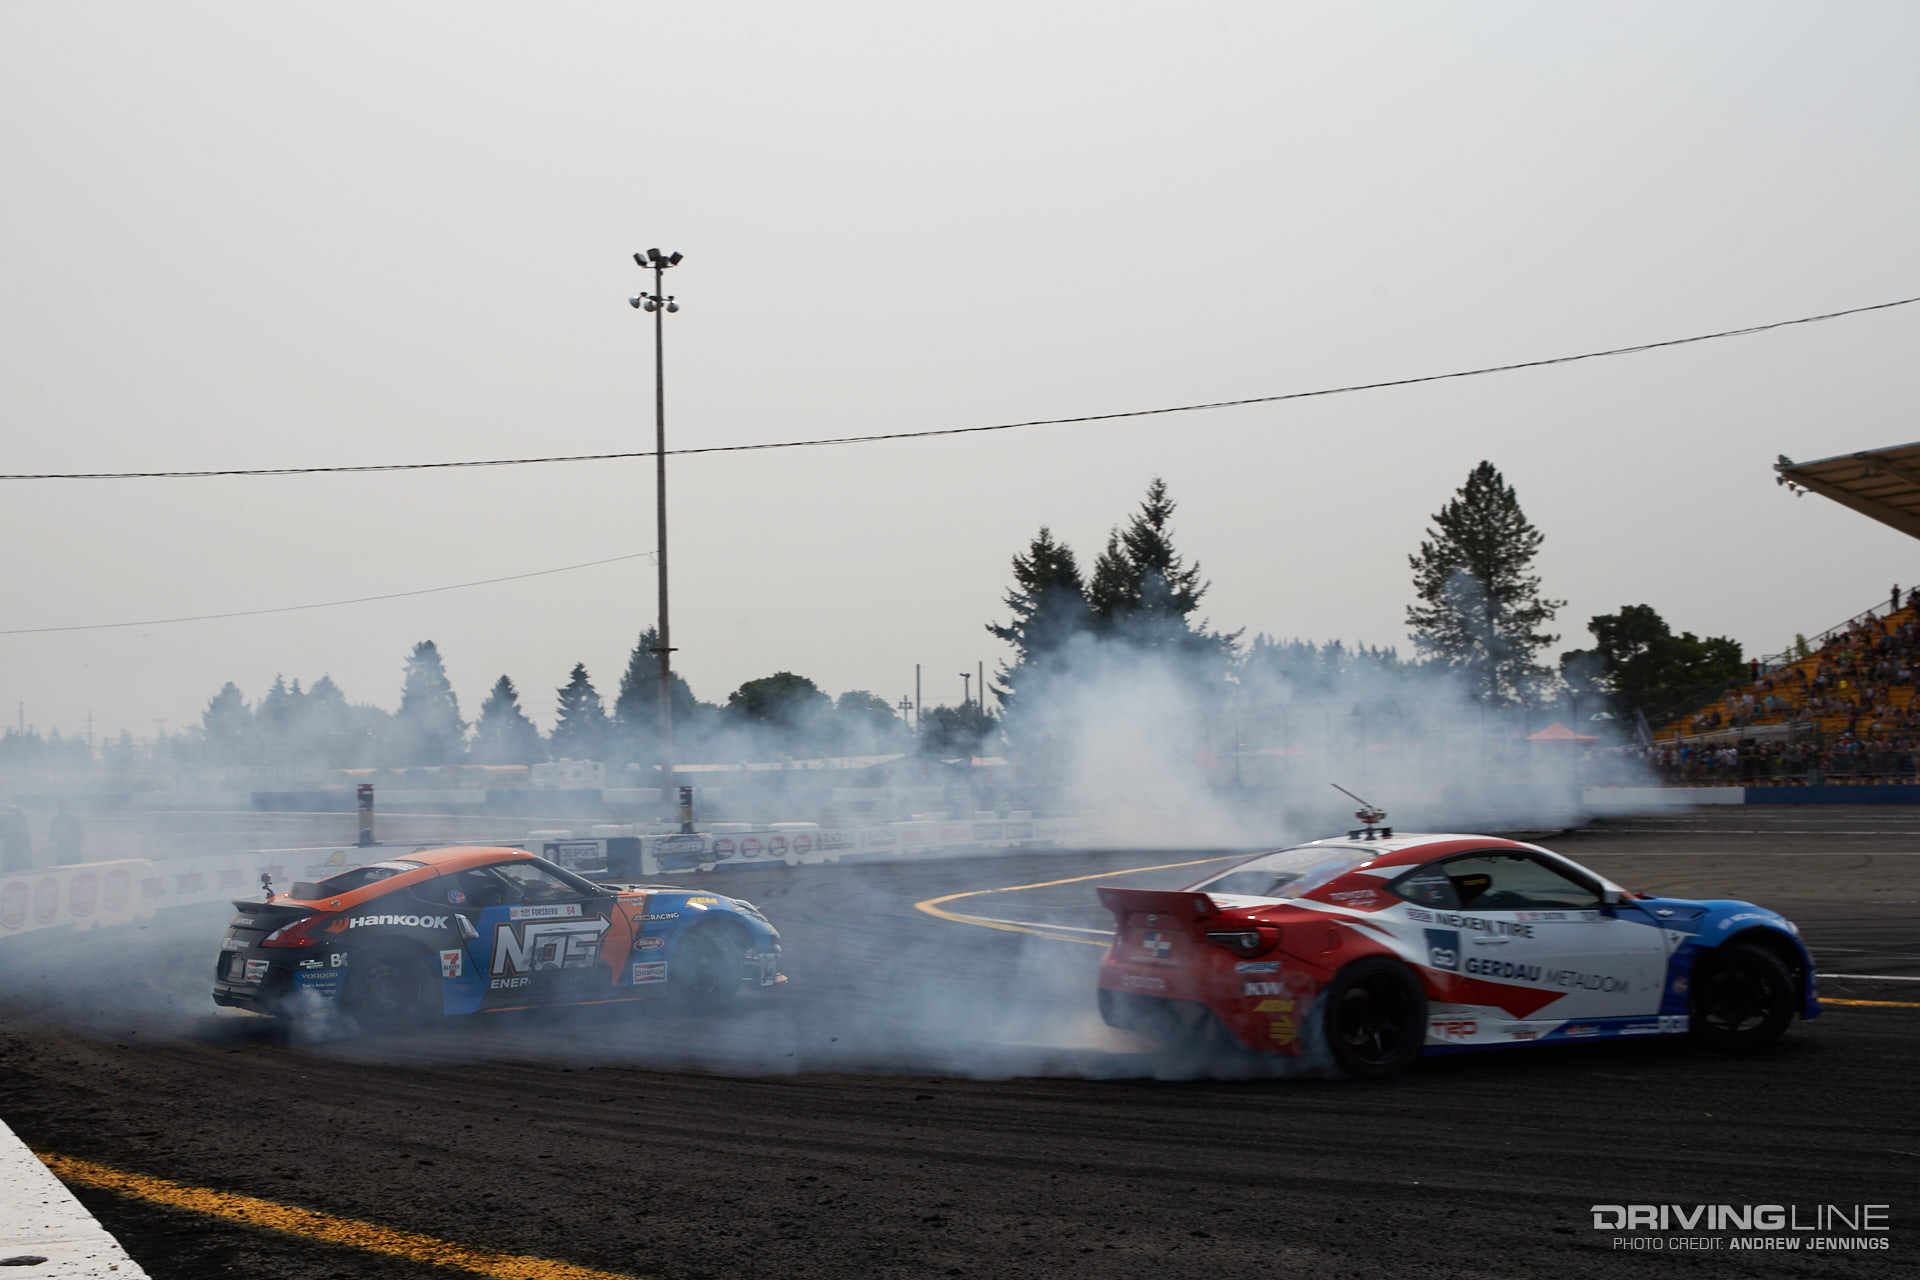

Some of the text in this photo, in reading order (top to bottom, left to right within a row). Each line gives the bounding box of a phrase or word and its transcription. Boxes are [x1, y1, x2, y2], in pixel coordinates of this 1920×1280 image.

[532, 906, 575, 916] FORSBERG 64
[650, 912, 680, 921] RACING
[1436, 912, 1494, 933] NEXEN
[1495, 920, 1535, 939] TIRE
[491, 917, 608, 976] NOS
[636, 968, 664, 978] CHAMPION
[1465, 957, 1630, 994] GERDAU METALDOM
[1245, 982, 1285, 995] KW
[1430, 1021, 1476, 1039] TRD
